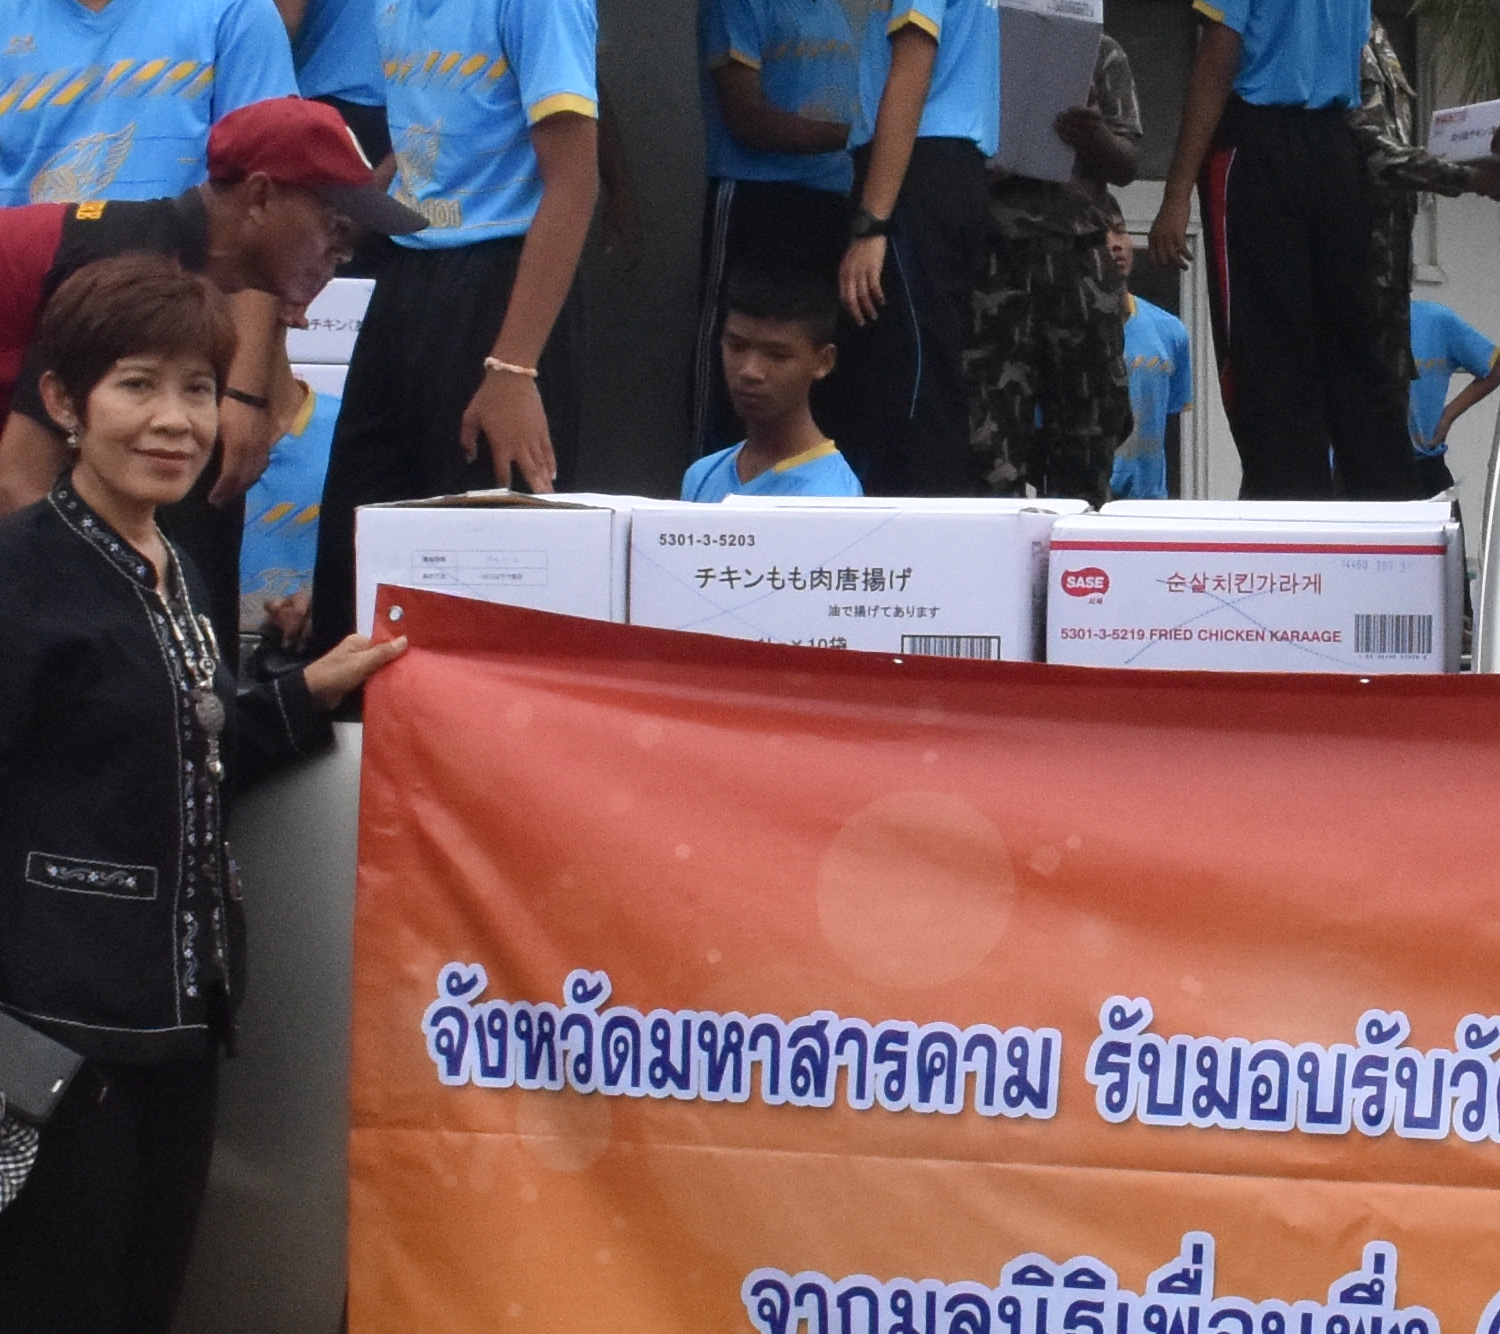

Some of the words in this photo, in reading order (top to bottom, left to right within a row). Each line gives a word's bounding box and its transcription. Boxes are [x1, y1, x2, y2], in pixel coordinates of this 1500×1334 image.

[659, 534, 756, 547] 5301-3-5203
[694, 566, 913, 592] チキンもも肉唐揚げ
[1066, 575, 1105, 590] SASE
[1167, 572, 1323, 595] 순살치킨가라게
[828, 604, 940, 618] 油で揚げてあります
[1061, 628, 1145, 641] 5301-3-5219
[1150, 628, 1193, 642] FRIED
[1198, 629, 1266, 642] CHICKEN
[1270, 629, 1342, 644] KARAAGE
[429, 970, 1054, 1110] จังหวัดมหาสารคาม
